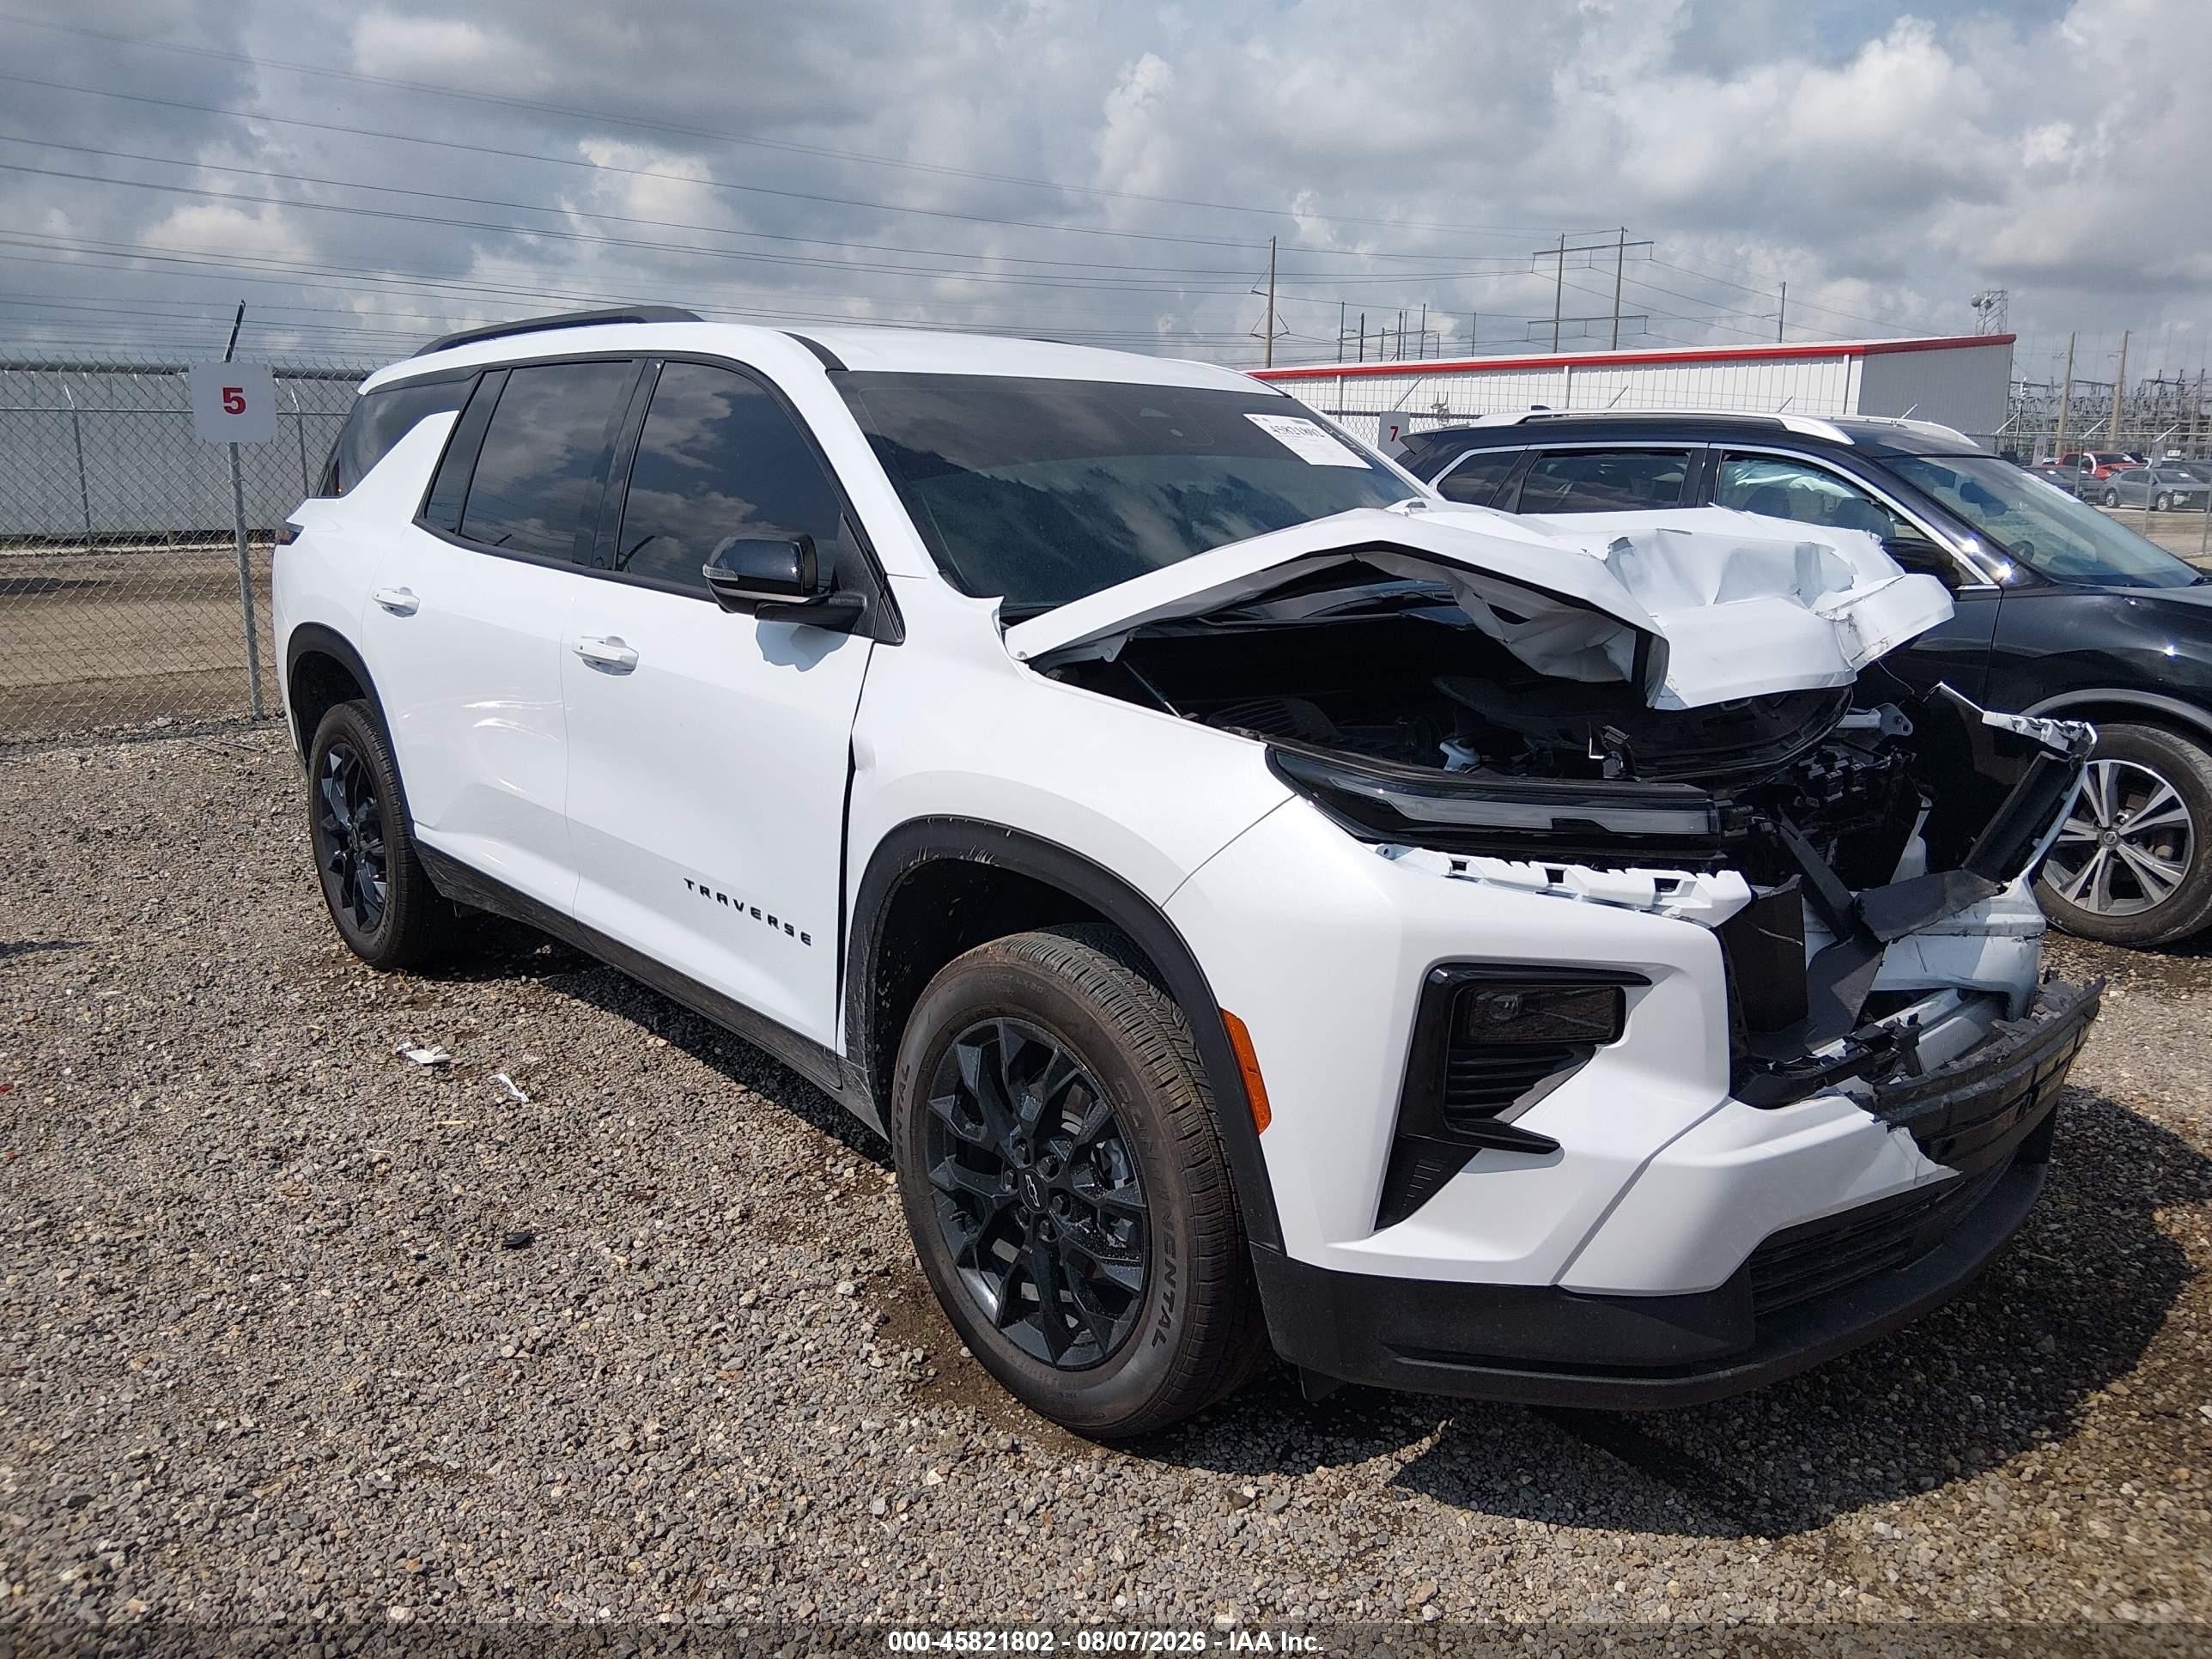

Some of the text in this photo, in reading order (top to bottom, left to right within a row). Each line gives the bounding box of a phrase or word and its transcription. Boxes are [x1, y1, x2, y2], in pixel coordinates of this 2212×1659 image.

[222, 387, 246, 415] 5
[1390, 425, 1399, 442] 7
[684, 878, 811, 947] TRAVERSE
